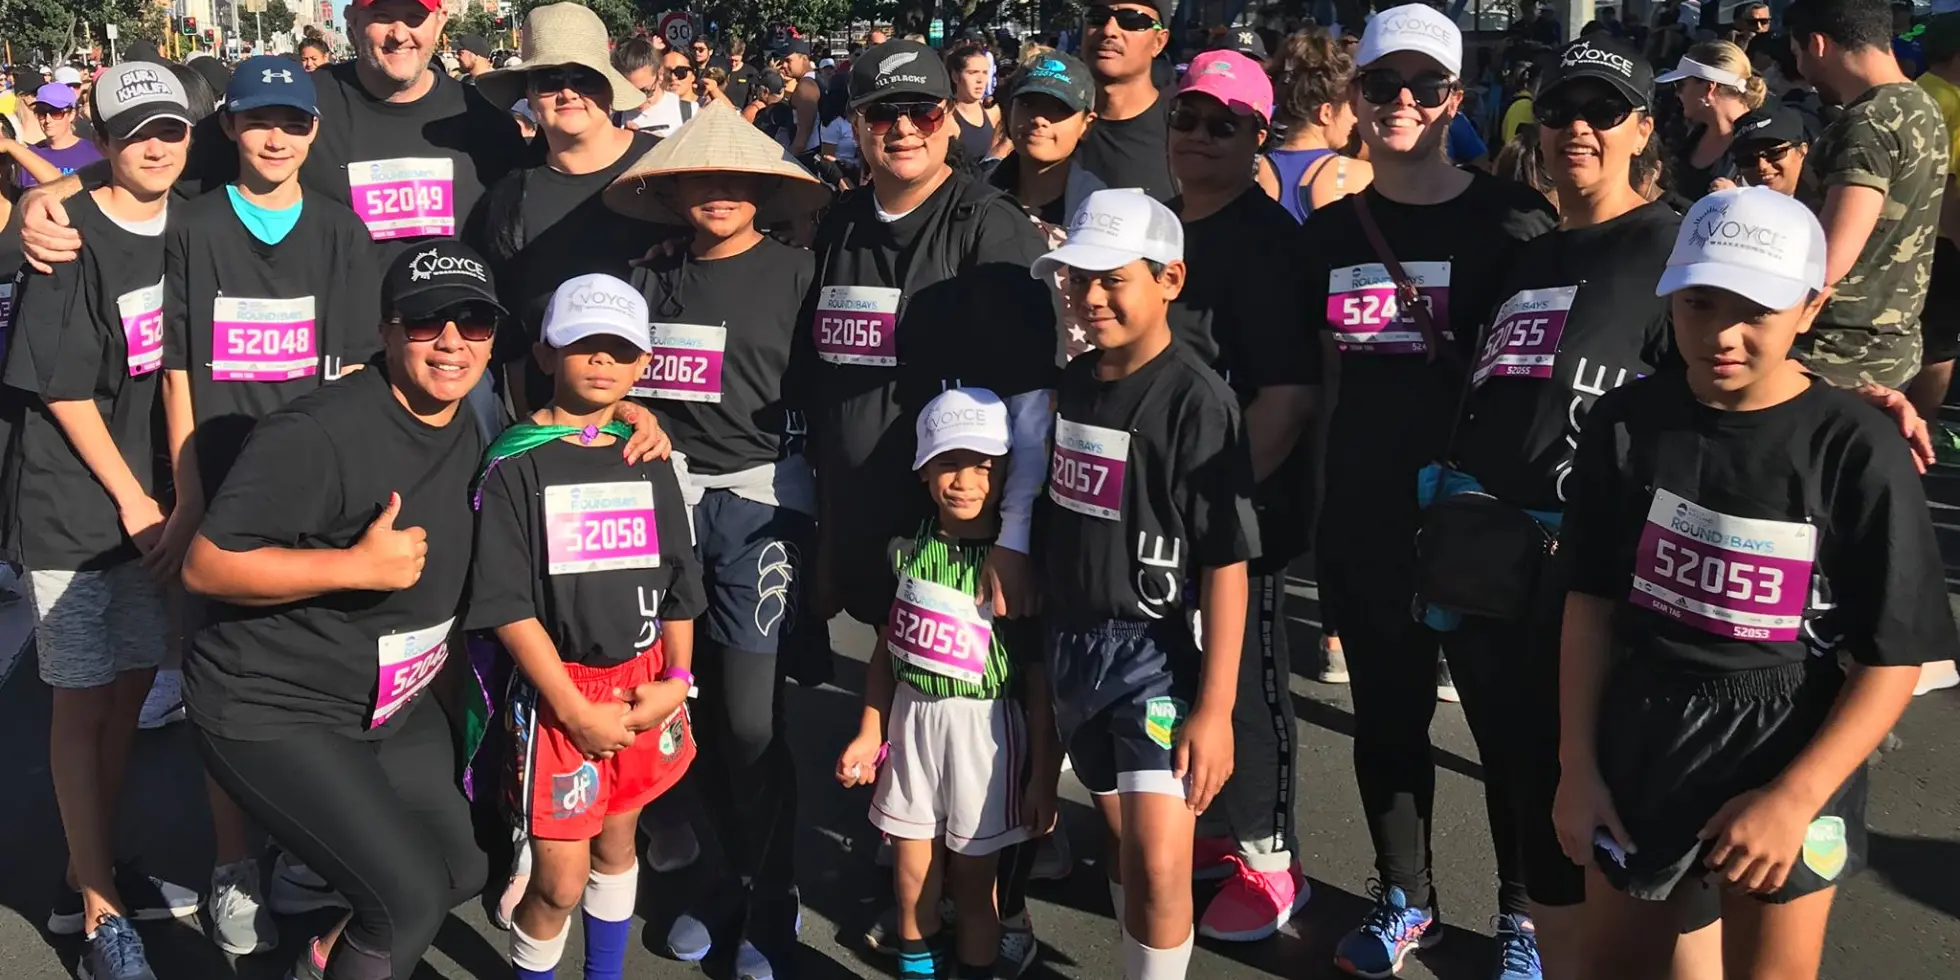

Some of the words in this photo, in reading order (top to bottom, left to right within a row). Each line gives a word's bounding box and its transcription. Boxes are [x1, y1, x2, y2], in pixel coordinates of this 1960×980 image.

[669, 25, 690, 40] 30
[1395, 19, 1451, 43] VOYCE
[1574, 49, 1633, 73] VOYCE
[121, 69, 158, 87] BURJ
[889, 75, 927, 84] BLACKS
[117, 81, 172, 102] KHALIFA
[366, 186, 443, 215] 52049
[1707, 220, 1787, 252] VOYCE
[423, 256, 485, 277] VOYCE
[580, 291, 636, 315] VOYCE
[227, 327, 309, 355] 52048
[821, 317, 882, 347] 52056
[1481, 318, 1549, 362] 52055
[932, 408, 986, 428] VOYCE
[566, 517, 647, 552] 52058
[1671, 517, 1723, 544] ROUND
[1730, 535, 1775, 553] BAYS
[1654, 537, 1784, 606] 52053
[894, 607, 972, 660] 52059
[1733, 626, 1770, 639] 52053
